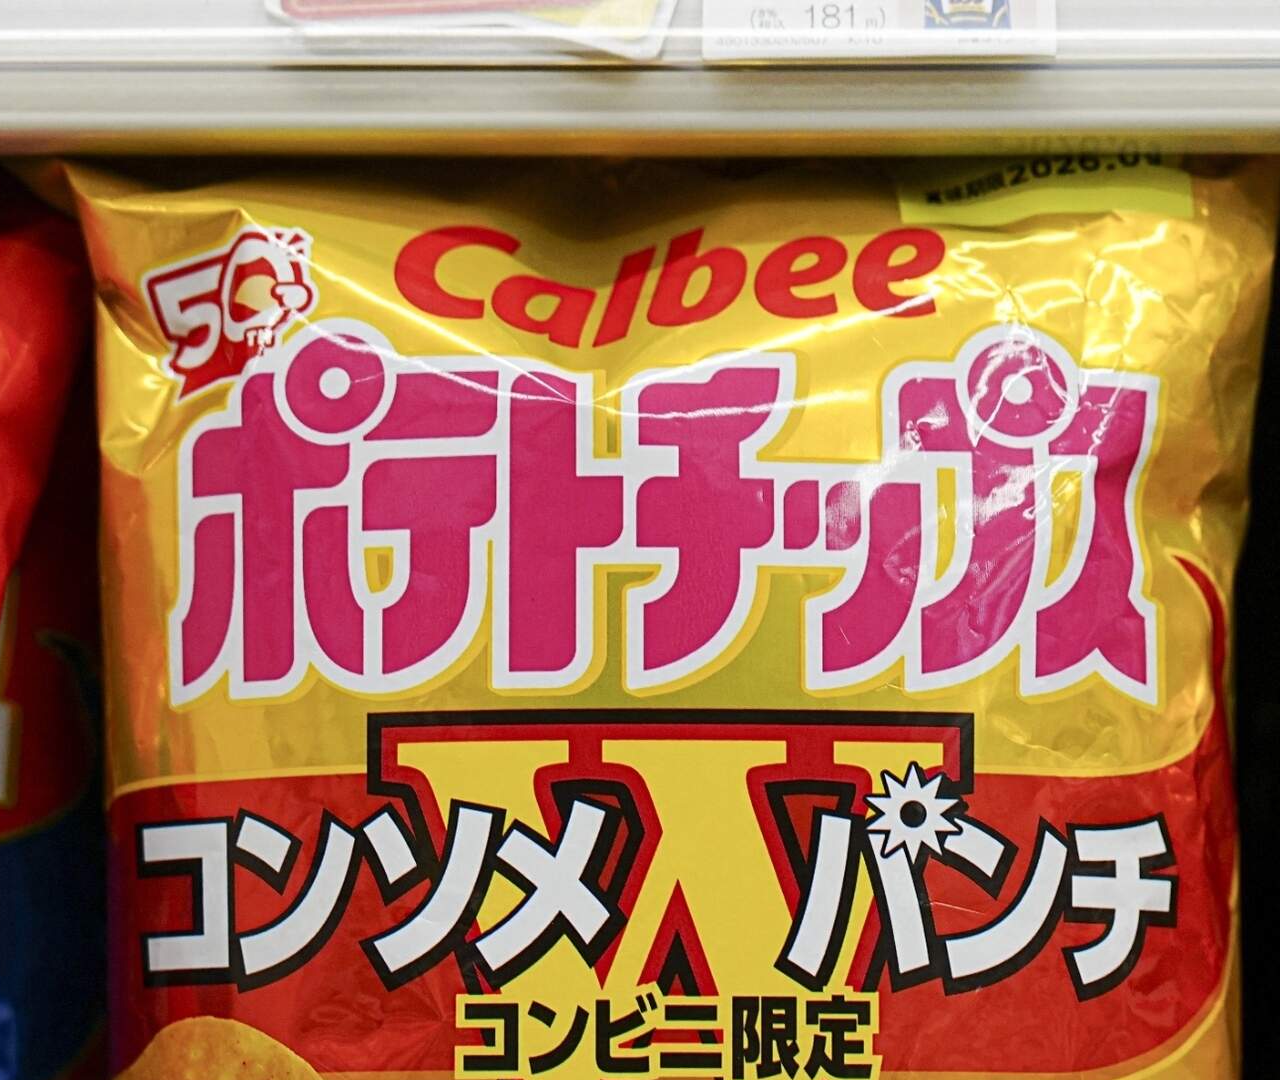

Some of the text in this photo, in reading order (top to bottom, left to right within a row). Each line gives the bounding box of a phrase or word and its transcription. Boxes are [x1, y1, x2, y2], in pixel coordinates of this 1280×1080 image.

[153, 236, 310, 370] 50
[393, 224, 947, 350] Calbee
[169, 318, 1163, 709] ポテトチップス
[135, 793, 625, 990] コンソメ
[784, 765, 1177, 992] パンチ
